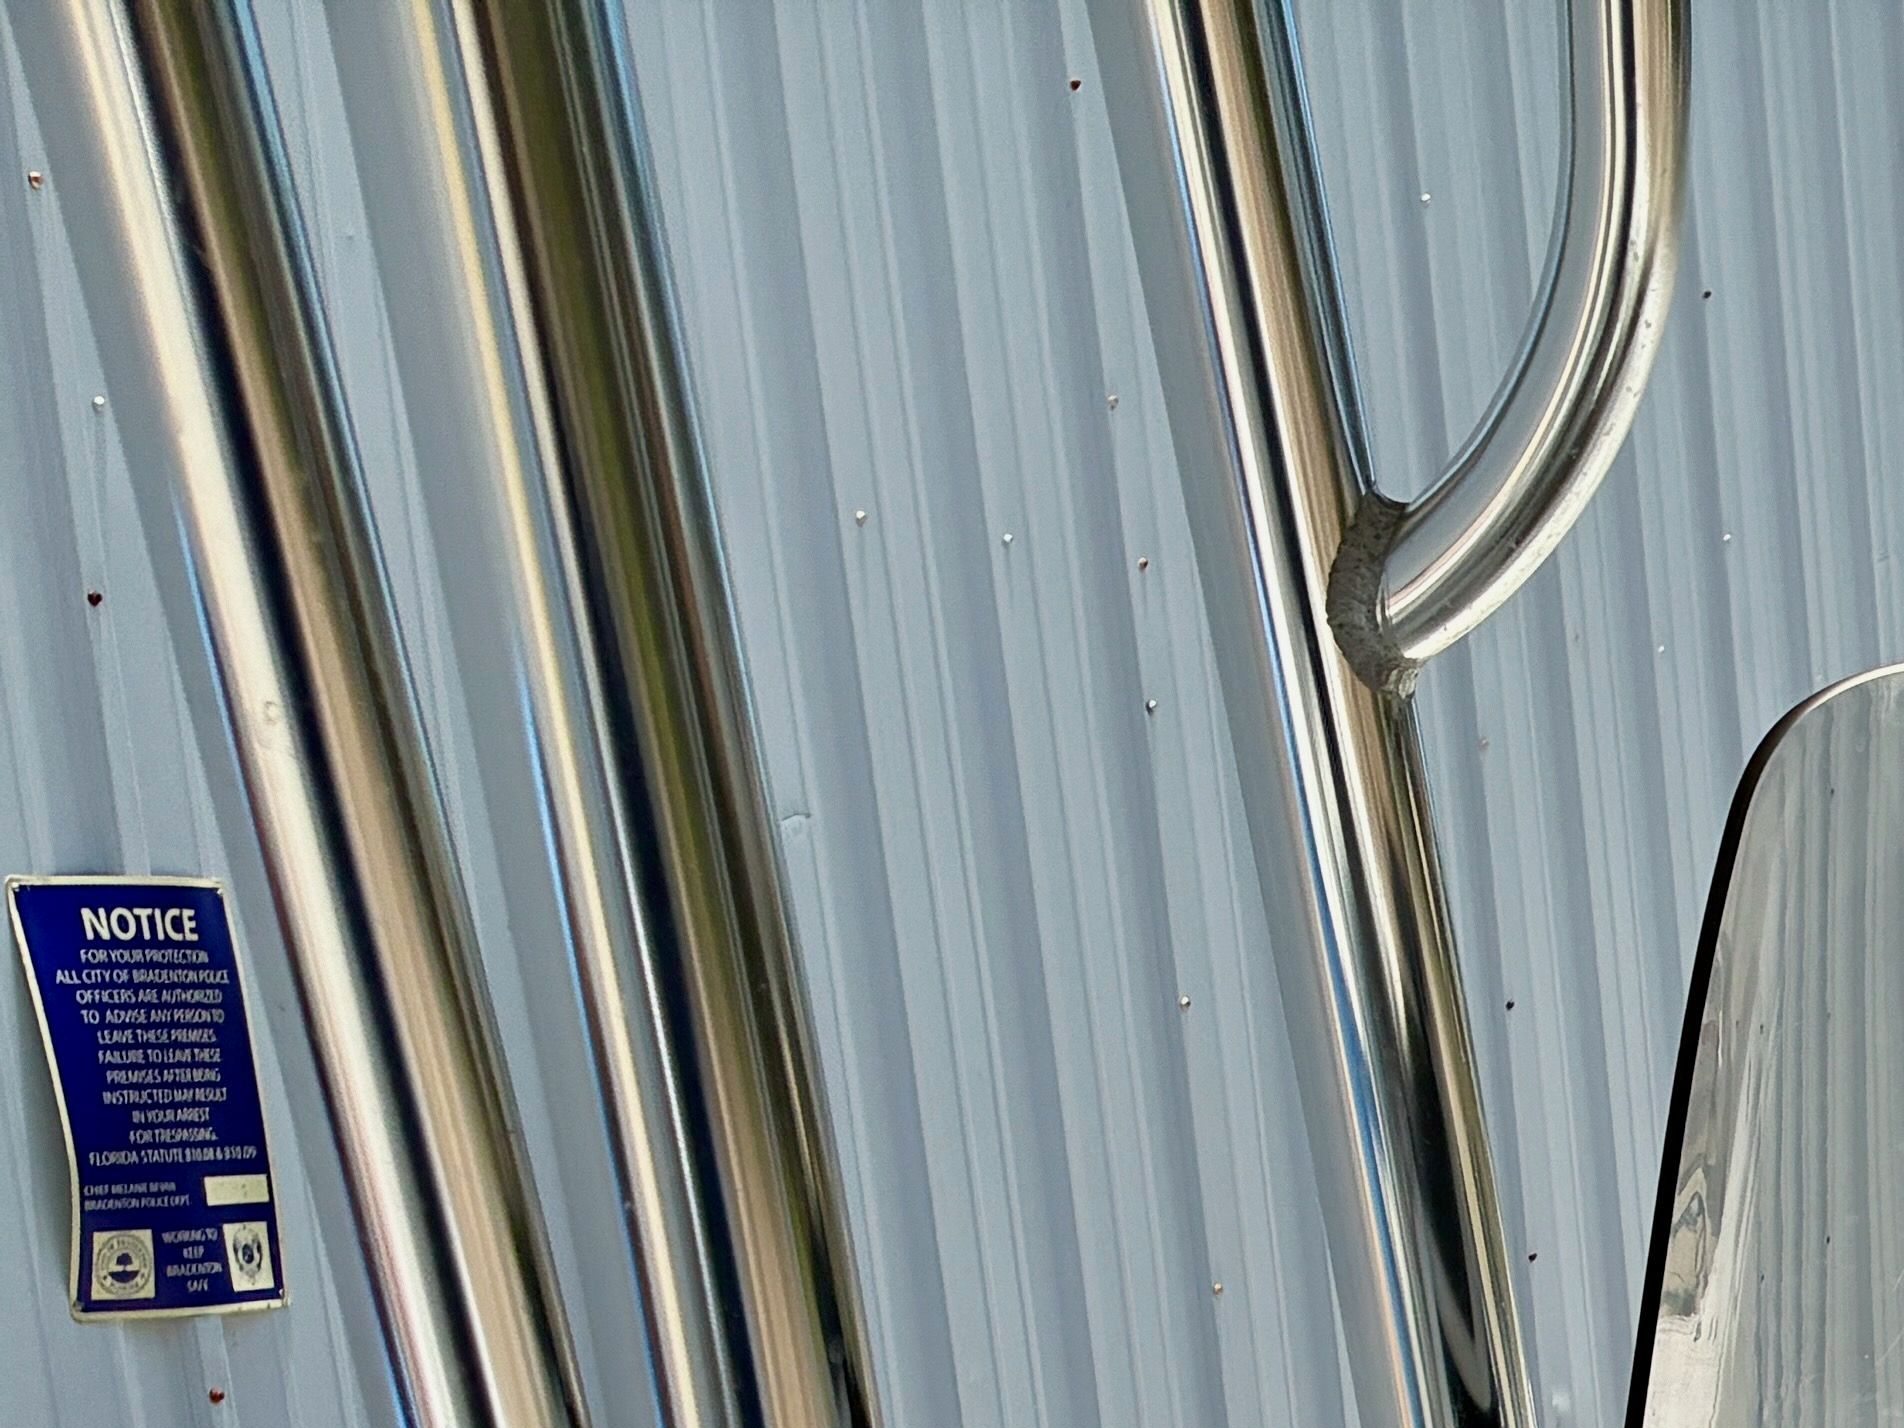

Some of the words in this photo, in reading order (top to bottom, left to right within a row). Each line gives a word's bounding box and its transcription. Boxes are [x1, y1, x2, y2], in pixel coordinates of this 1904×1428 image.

[81, 907, 199, 941] NOTICE
[80, 949, 107, 963] FOR
[109, 949, 144, 963] YOUR
[56, 970, 81, 984] ALL
[82, 970, 111, 984] CITY
[113, 969, 130, 983] OF
[76, 990, 136, 1004] OFFICERS
[138, 989, 159, 1003] ARE
[80, 1010, 99, 1024] TO
[105, 1009, 148, 1024] ADVISE
[97, 1030, 135, 1044] LEAVE
[149, 1049, 162, 1063] TO
